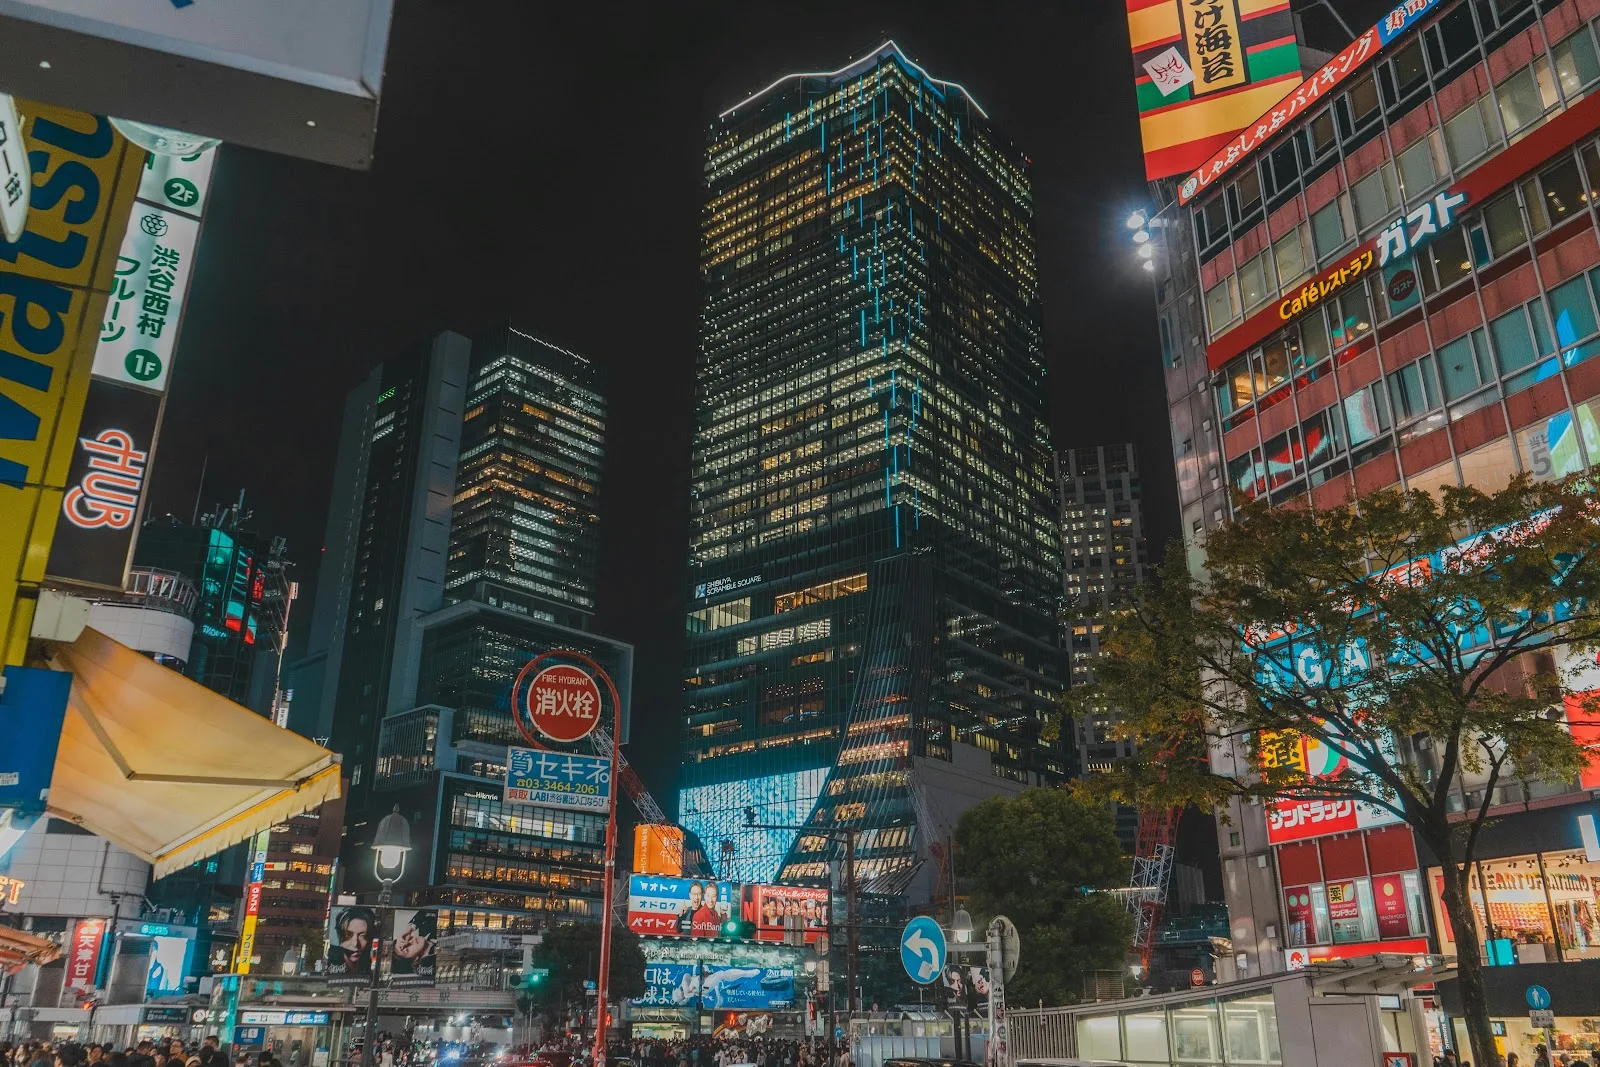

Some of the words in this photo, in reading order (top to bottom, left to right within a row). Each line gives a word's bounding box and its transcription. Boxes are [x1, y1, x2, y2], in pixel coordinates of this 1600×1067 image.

[1190, 0, 1234, 84] け海苔
[1198, 29, 1375, 186] しゃぶしゃぶバイキング
[170, 182, 194, 203] 2F
[1376, 191, 1466, 268] ガスト
[137, 244, 180, 339] 渋谷西村
[1279, 249, 1374, 320] Caféレストラン
[100, 255, 141, 343] フルーツ
[135, 354, 157, 377] 1F
[63, 427, 148, 531] HUB
[706, 576, 733, 588] SHIBUYA
[706, 581, 738, 596] SCRAMBLE
[737, 574, 762, 588] SQUARE
[541, 674, 557, 684] FIRE
[558, 676, 590, 687] HYDRANT
[535, 687, 595, 719] 消火栓
[508, 788, 528, 800] 買取
[525, 778, 600, 795] 03-3464-2061
[1270, 799, 1353, 831] サンドラッグ
[1546, 872, 1590, 892] ATHING
[639, 900, 677, 910] オドロク
[631, 917, 677, 929] ペイトク
